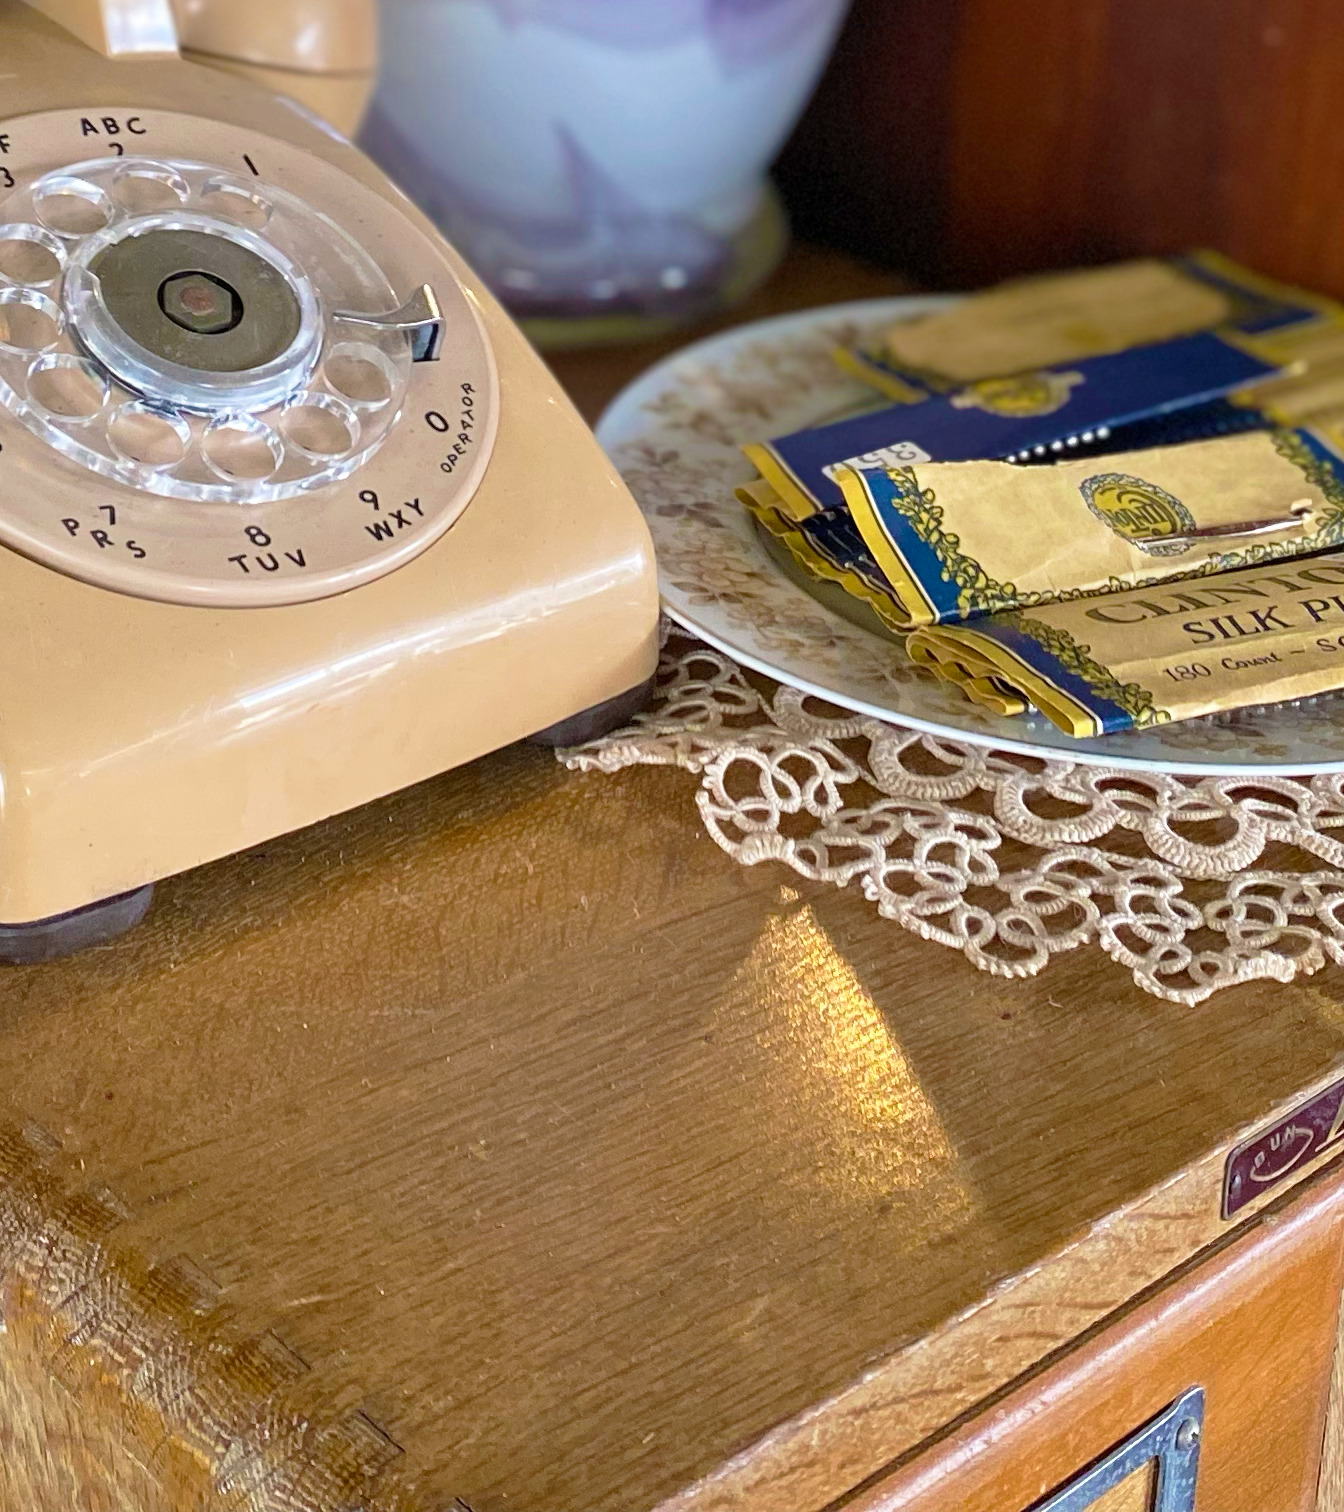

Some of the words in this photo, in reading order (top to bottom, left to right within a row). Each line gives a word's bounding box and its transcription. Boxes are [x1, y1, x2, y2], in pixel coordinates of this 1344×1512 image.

[80, 117, 147, 136] ABC
[243, 153, 260, 177] 1
[439, 382, 477, 474] OPERATOR
[359, 490, 380, 512] 9
[98, 504, 117, 526] 7
[364, 496, 425, 542] WXY
[61, 516, 147, 559] PRS
[243, 526, 272, 548] 8
[228, 547, 307, 574] TUV
[1182, 604, 1295, 646] SILK
[1161, 661, 1212, 685] 180
[1221, 651, 1284, 672] Count
